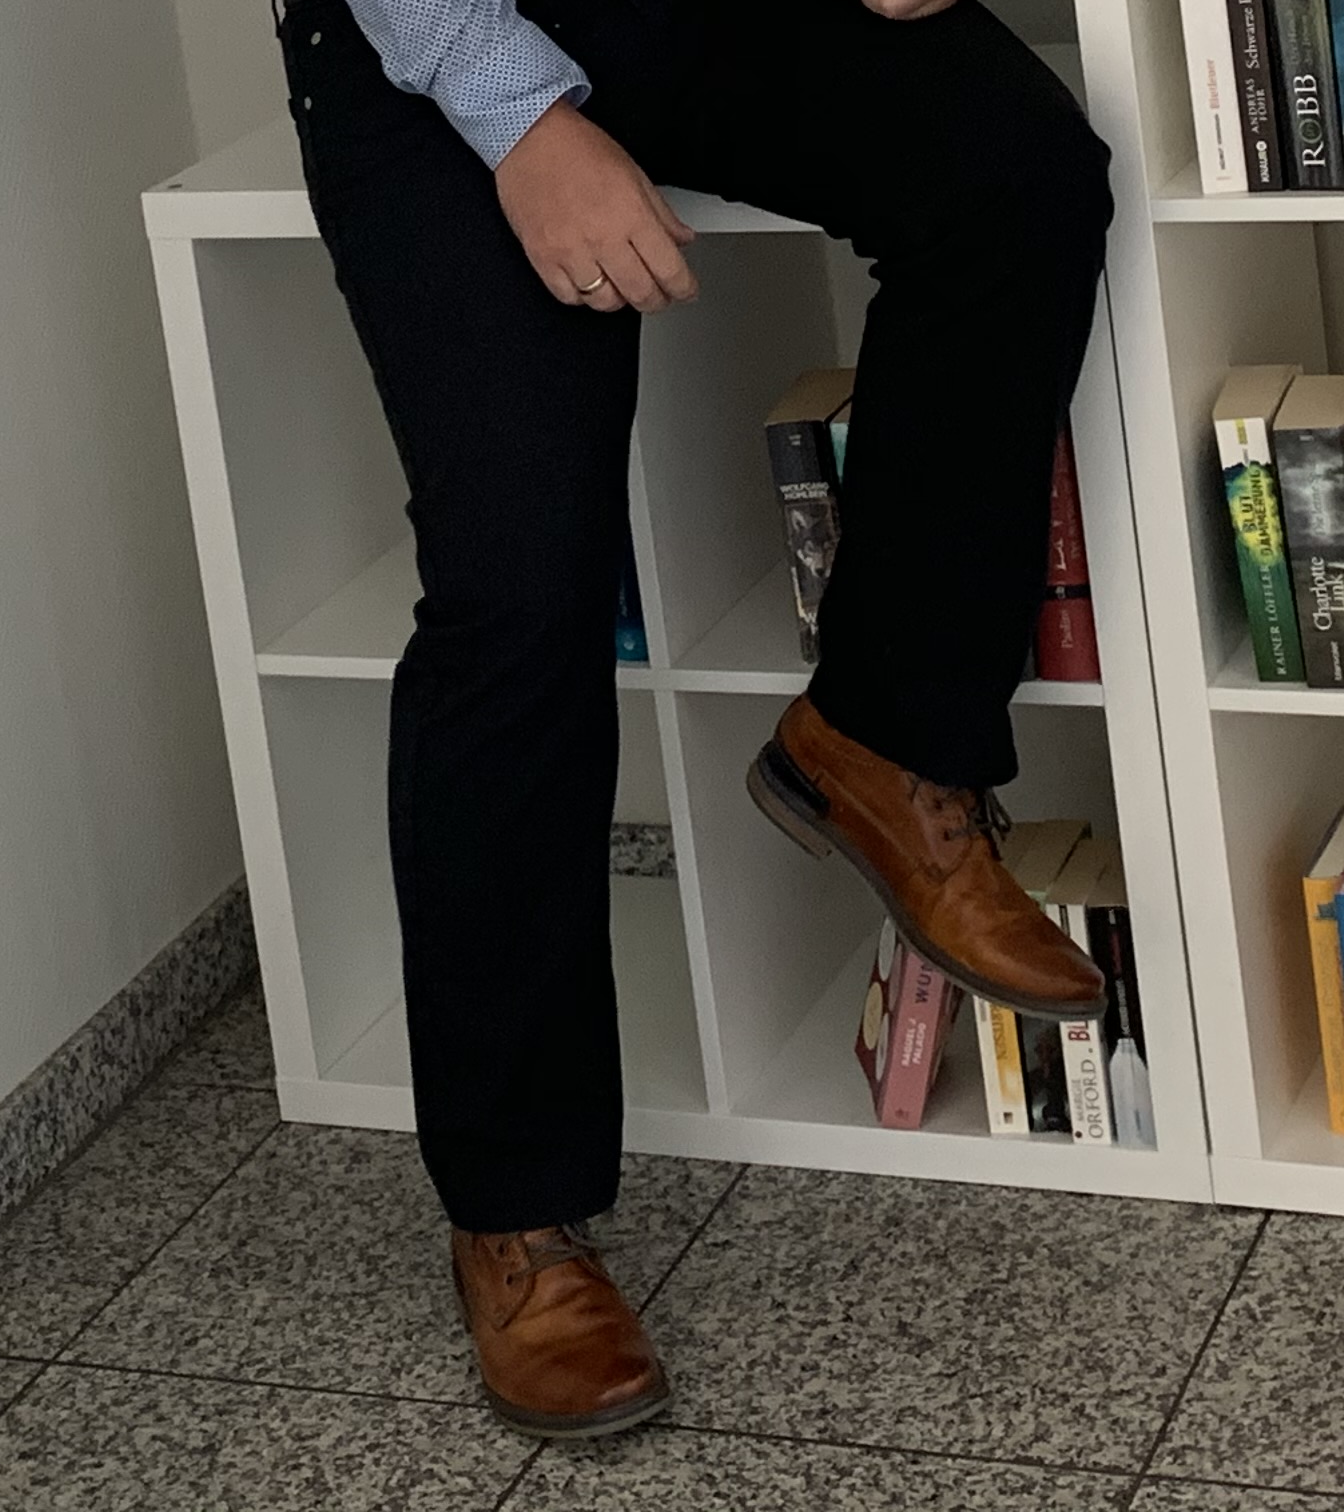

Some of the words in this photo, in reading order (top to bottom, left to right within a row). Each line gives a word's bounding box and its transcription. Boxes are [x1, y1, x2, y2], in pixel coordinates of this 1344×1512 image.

[1242, 6, 1260, 69] Schwarze
[1244, 77, 1261, 134] ANDREAS
[779, 481, 830, 495] WOLFGANG
[1311, 555, 1332, 631] Charlotte
[1269, 624, 1286, 676] RAINER
[911, 1022, 927, 1065] PALACIO
[1081, 1058, 1104, 1140] ORFORD
